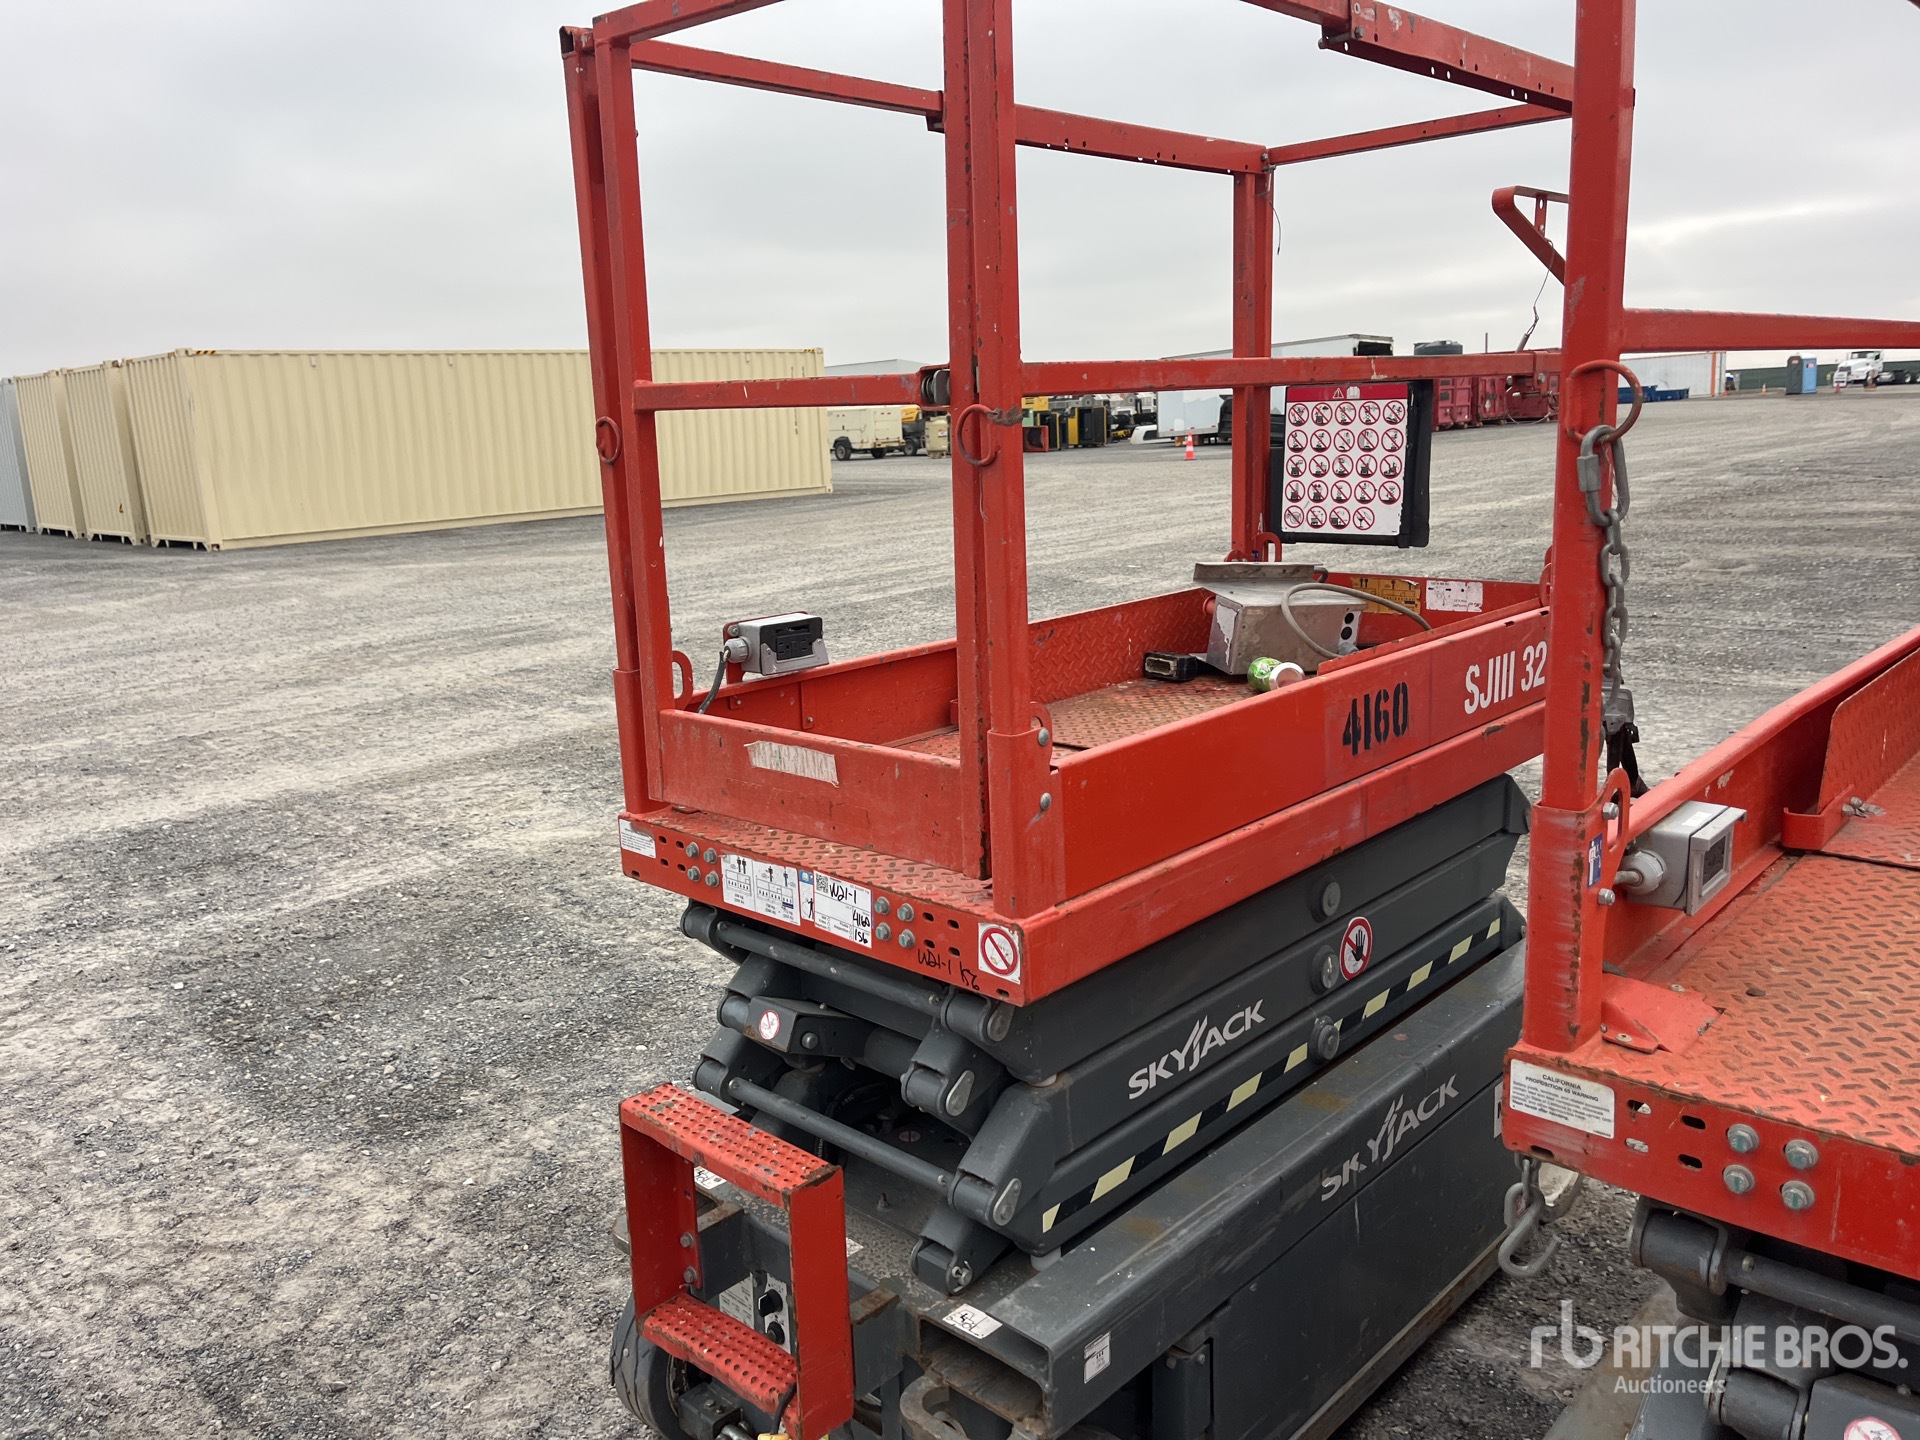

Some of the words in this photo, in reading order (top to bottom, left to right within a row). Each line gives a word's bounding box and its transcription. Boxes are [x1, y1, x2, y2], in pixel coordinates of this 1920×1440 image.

[1521, 641, 1547, 692] 32
[1343, 682, 1409, 756] 4160
[1128, 999, 1266, 1100] SKYJACK
[1525, 1076, 1563, 1093] PROPOSITION
[1572, 1089, 1600, 1102] WARNING
[1542, 1074, 1582, 1090] CALIFORNIA
[1321, 1073, 1460, 1202] SKYJACK
